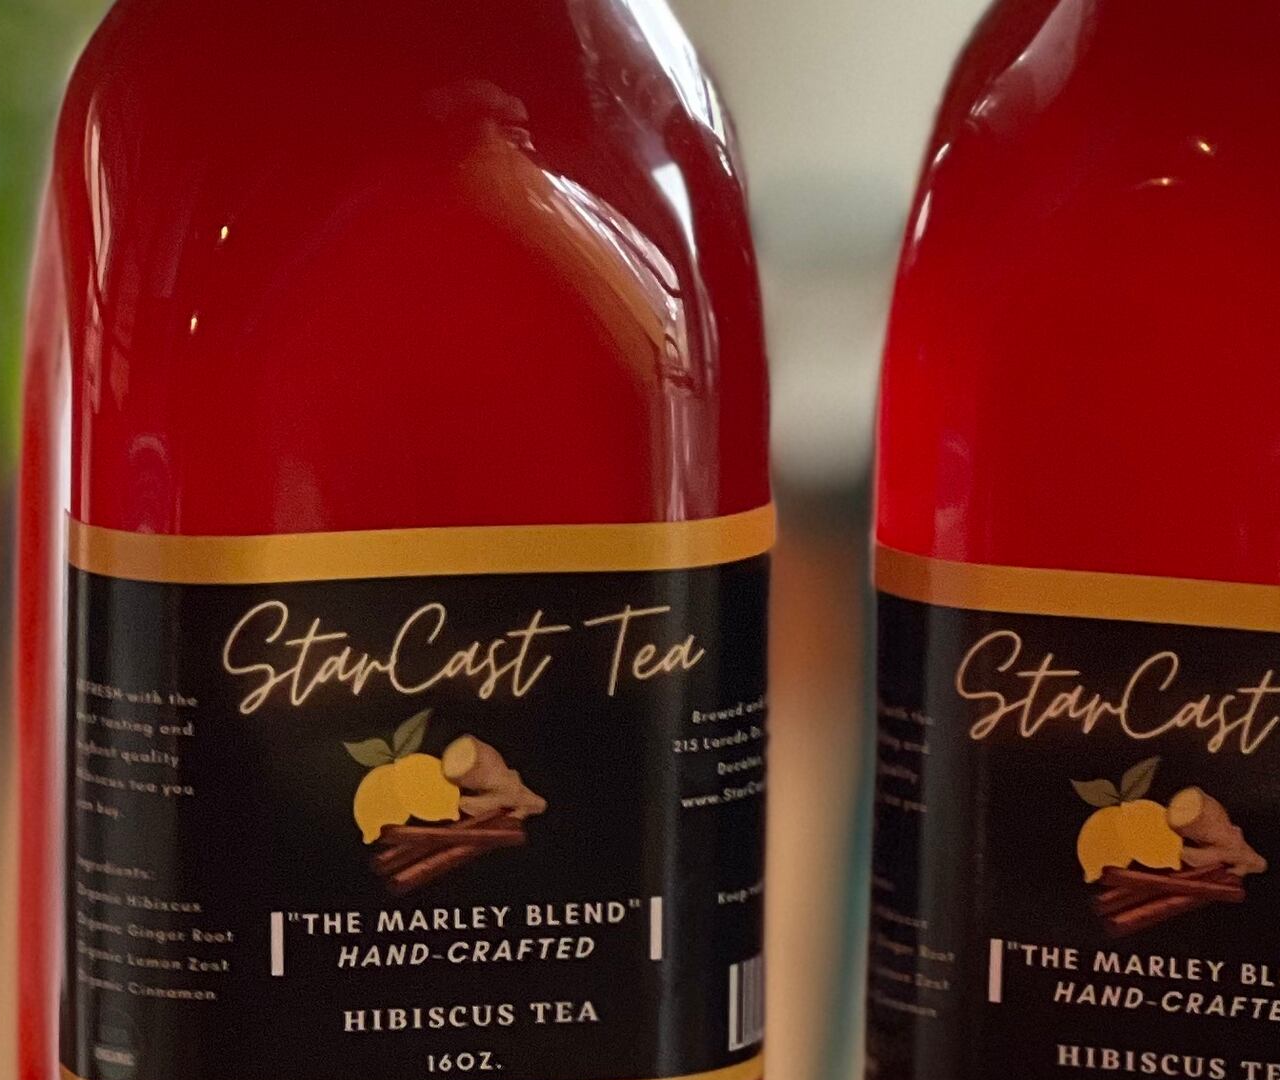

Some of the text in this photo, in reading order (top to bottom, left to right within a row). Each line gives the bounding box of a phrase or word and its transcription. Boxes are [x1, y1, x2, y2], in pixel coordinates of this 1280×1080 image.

[223, 600, 706, 715] StarCast Tea
[160, 721, 194, 736] and
[673, 738, 699, 753] 215
[121, 750, 179, 768] quality
[161, 783, 195, 798] you
[288, 899, 641, 936] "THE MARLEY BLEND"
[127, 923, 186, 945] Ginger
[192, 927, 235, 944] Root
[127, 952, 183, 970] Lemon
[337, 936, 596, 969] HAND-CRAFTED
[1007, 941, 1080, 971] "THE
[1093, 950, 1225, 983] MARLEY
[127, 981, 217, 1001] Cinnamon
[343, 1000, 601, 1033] HIBISCUS TEA
[1057, 1044, 1227, 1080] HIBISCUS
